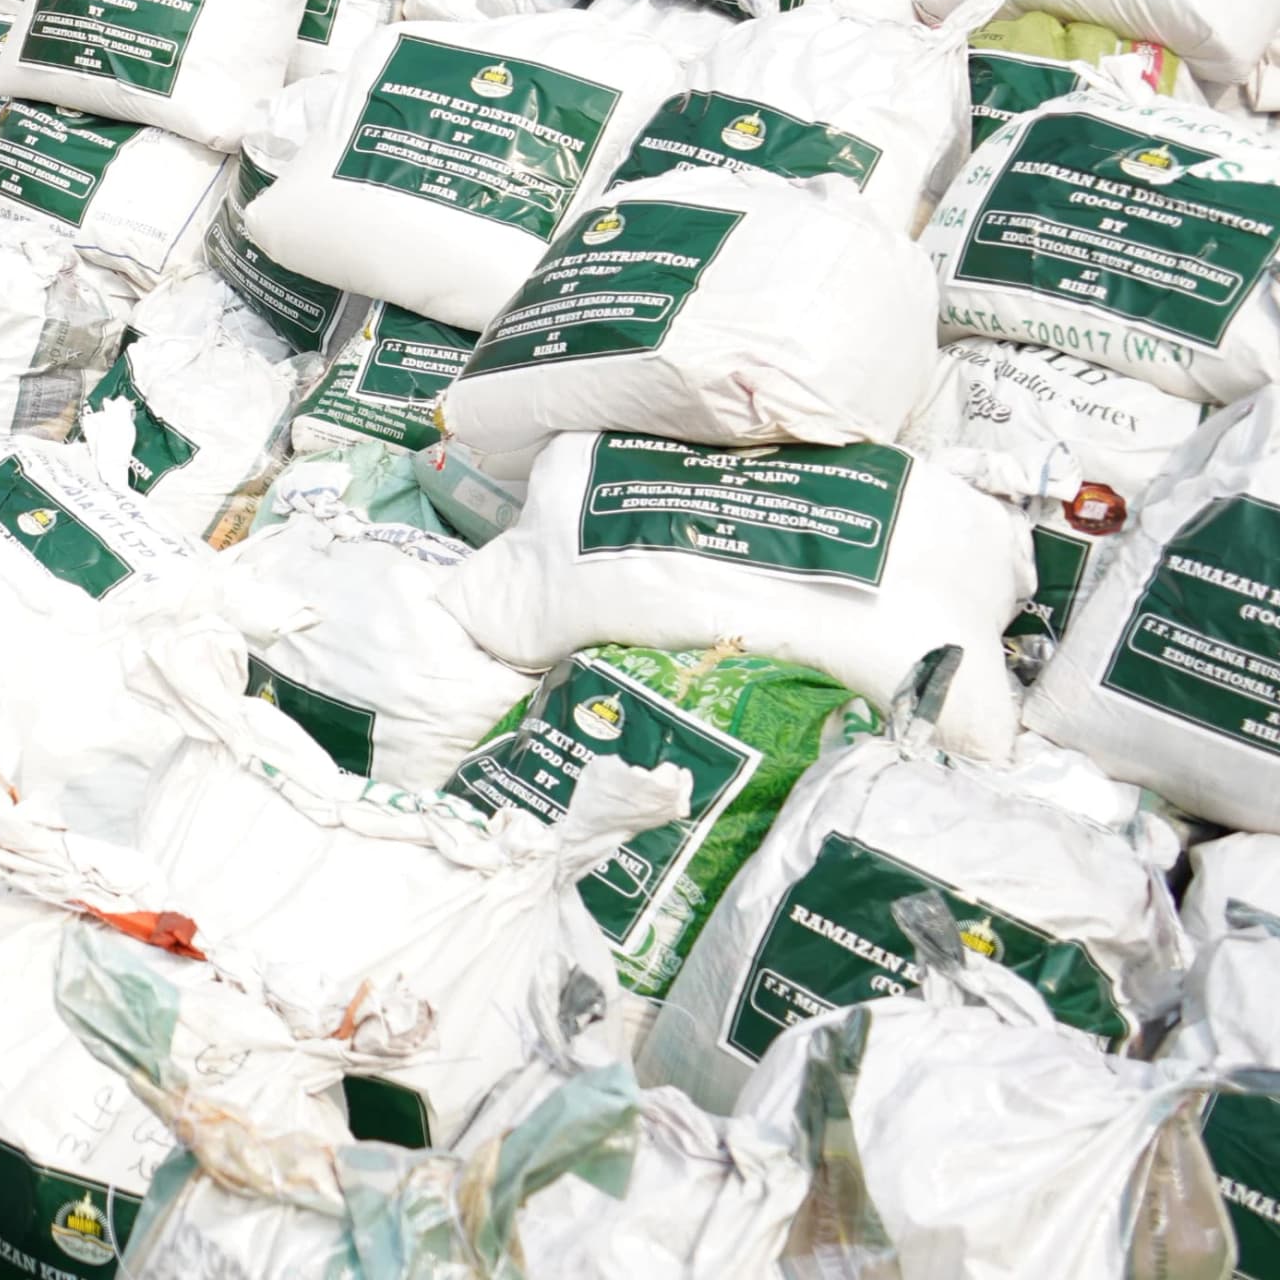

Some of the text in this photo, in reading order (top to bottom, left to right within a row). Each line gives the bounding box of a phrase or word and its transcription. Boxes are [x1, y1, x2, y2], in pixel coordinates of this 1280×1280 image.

[88, 5, 105, 18] BY
[381, 82, 585, 153] RAMAZAN KIT DISTRIBUTION
[430, 108, 516, 140] (FOOD GRAIN)
[24, 134, 39, 146] BY
[452, 132, 474, 144] BY
[640, 136, 725, 166] RAMAZAN KIT
[420, 182, 458, 201] BIHAR
[1011, 160, 1094, 187] RAMAZAN
[1095, 178, 1132, 198] KIT
[1131, 187, 1273, 237] DISTRIBUTION
[1069, 191, 1183, 228] (FOOD GRAIN)
[1098, 218, 1129, 234] BY
[245, 248, 259, 263] BY
[558, 250, 701, 270] KIT DISTRIBUTION
[1079, 270, 1099, 281] AT
[259, 275, 321, 318] AHMAD MADANI
[560, 281, 579, 293] BY
[1058, 279, 1108, 300] BIHAR
[264, 292, 300, 319] DEOBAND
[616, 294, 666, 308] MADANI
[1022, 319, 1113, 357] 700017
[405, 345, 458, 361] MAULANA
[533, 342, 567, 357] BIHAR
[621, 498, 840, 536] EDUCATIONAL TRUST DEOBAND
[627, 485, 693, 496] MAULANA
[694, 487, 755, 505] HUSSAIN
[756, 496, 809, 514] AHMAD
[811, 504, 874, 529] MADANI
[716, 523, 736, 535] AT
[697, 534, 750, 554] BIHAR
[1168, 554, 1269, 600] RAMAZAN
[1170, 628, 1246, 669] MAULANA
[1162, 646, 1276, 700] EDUCATIONAL
[547, 728, 577, 754] KIT
[533, 769, 561, 789] BY
[788, 903, 904, 972] RAMAZAN
